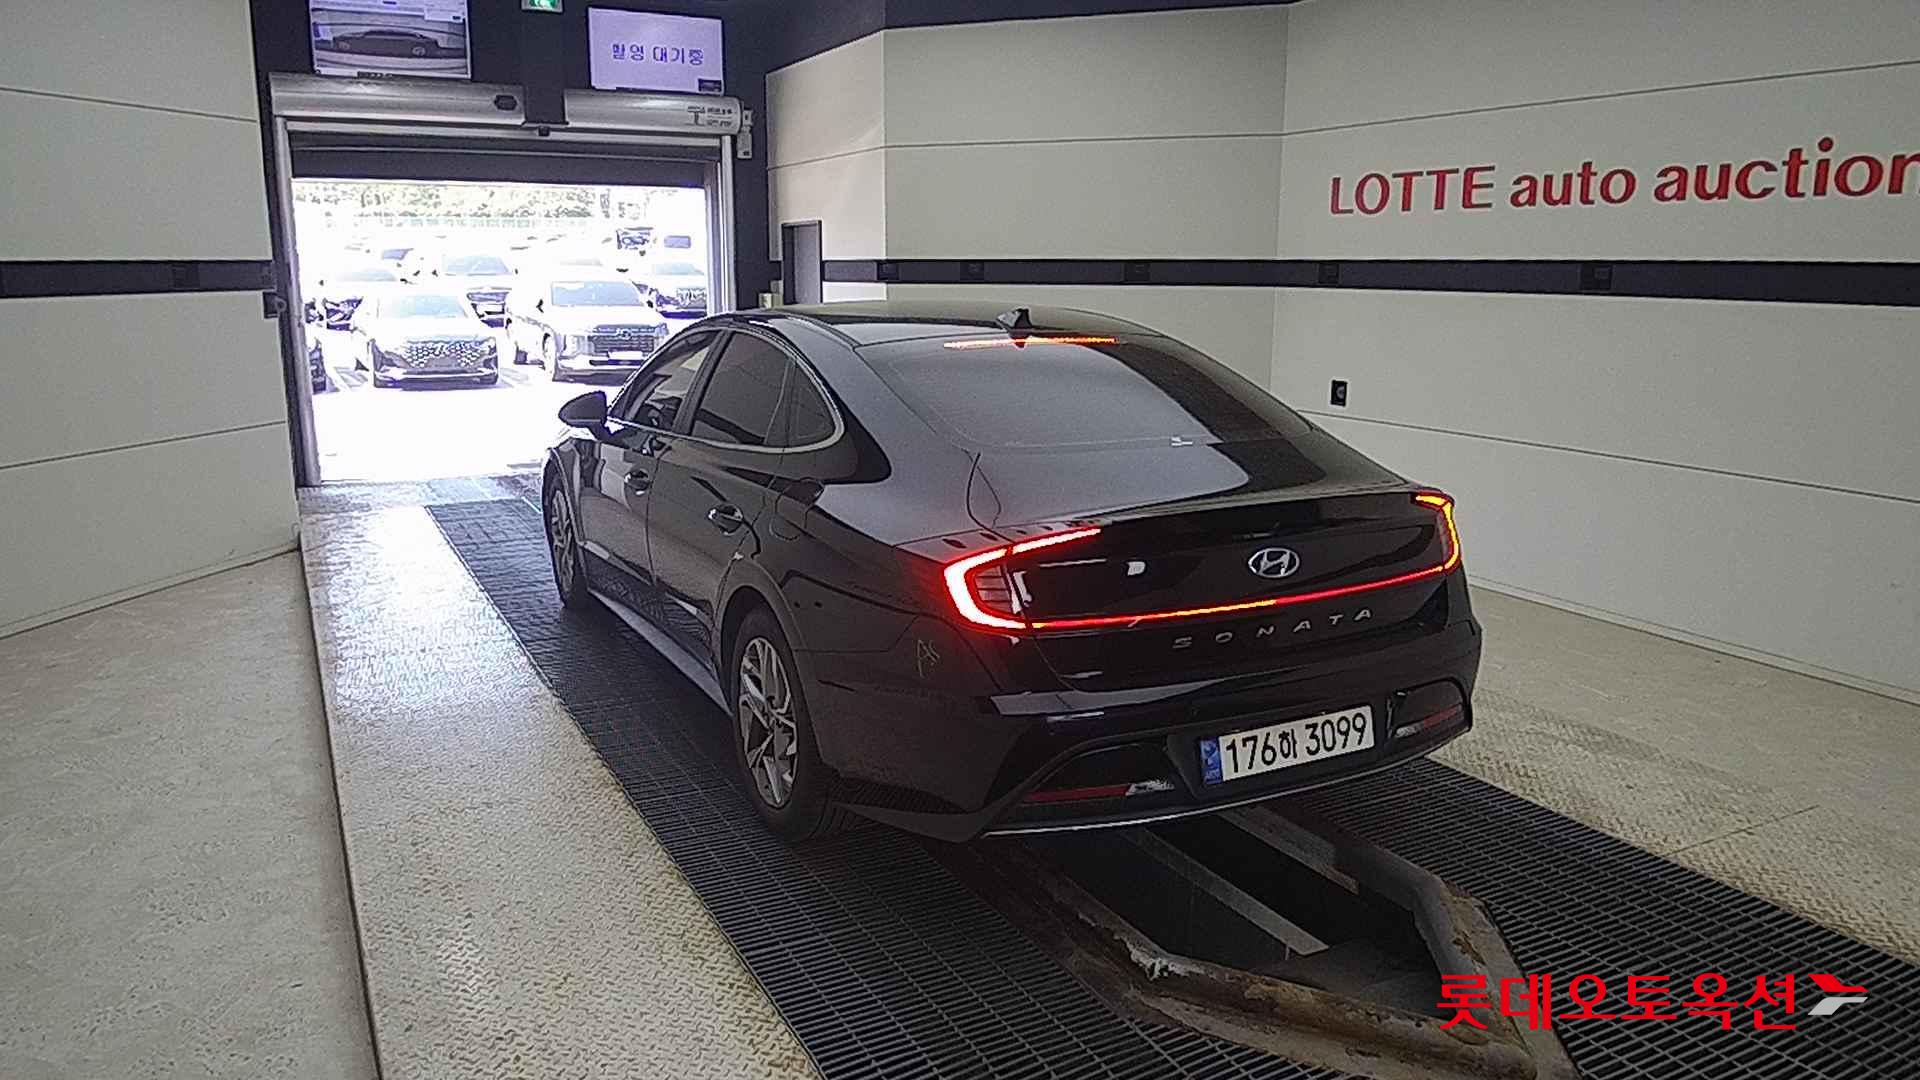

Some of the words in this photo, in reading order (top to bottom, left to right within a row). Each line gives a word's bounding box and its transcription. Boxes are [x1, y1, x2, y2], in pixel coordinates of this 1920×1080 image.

[652, 46, 704, 66] 대기중
[1330, 165, 1496, 215] LOTTE
[1510, 161, 1637, 208] auto
[1654, 136, 1920, 202] auction
[1172, 608, 1373, 650] SONATA
[1225, 728, 1298, 774] 176하
[1304, 712, 1368, 756] 3099
